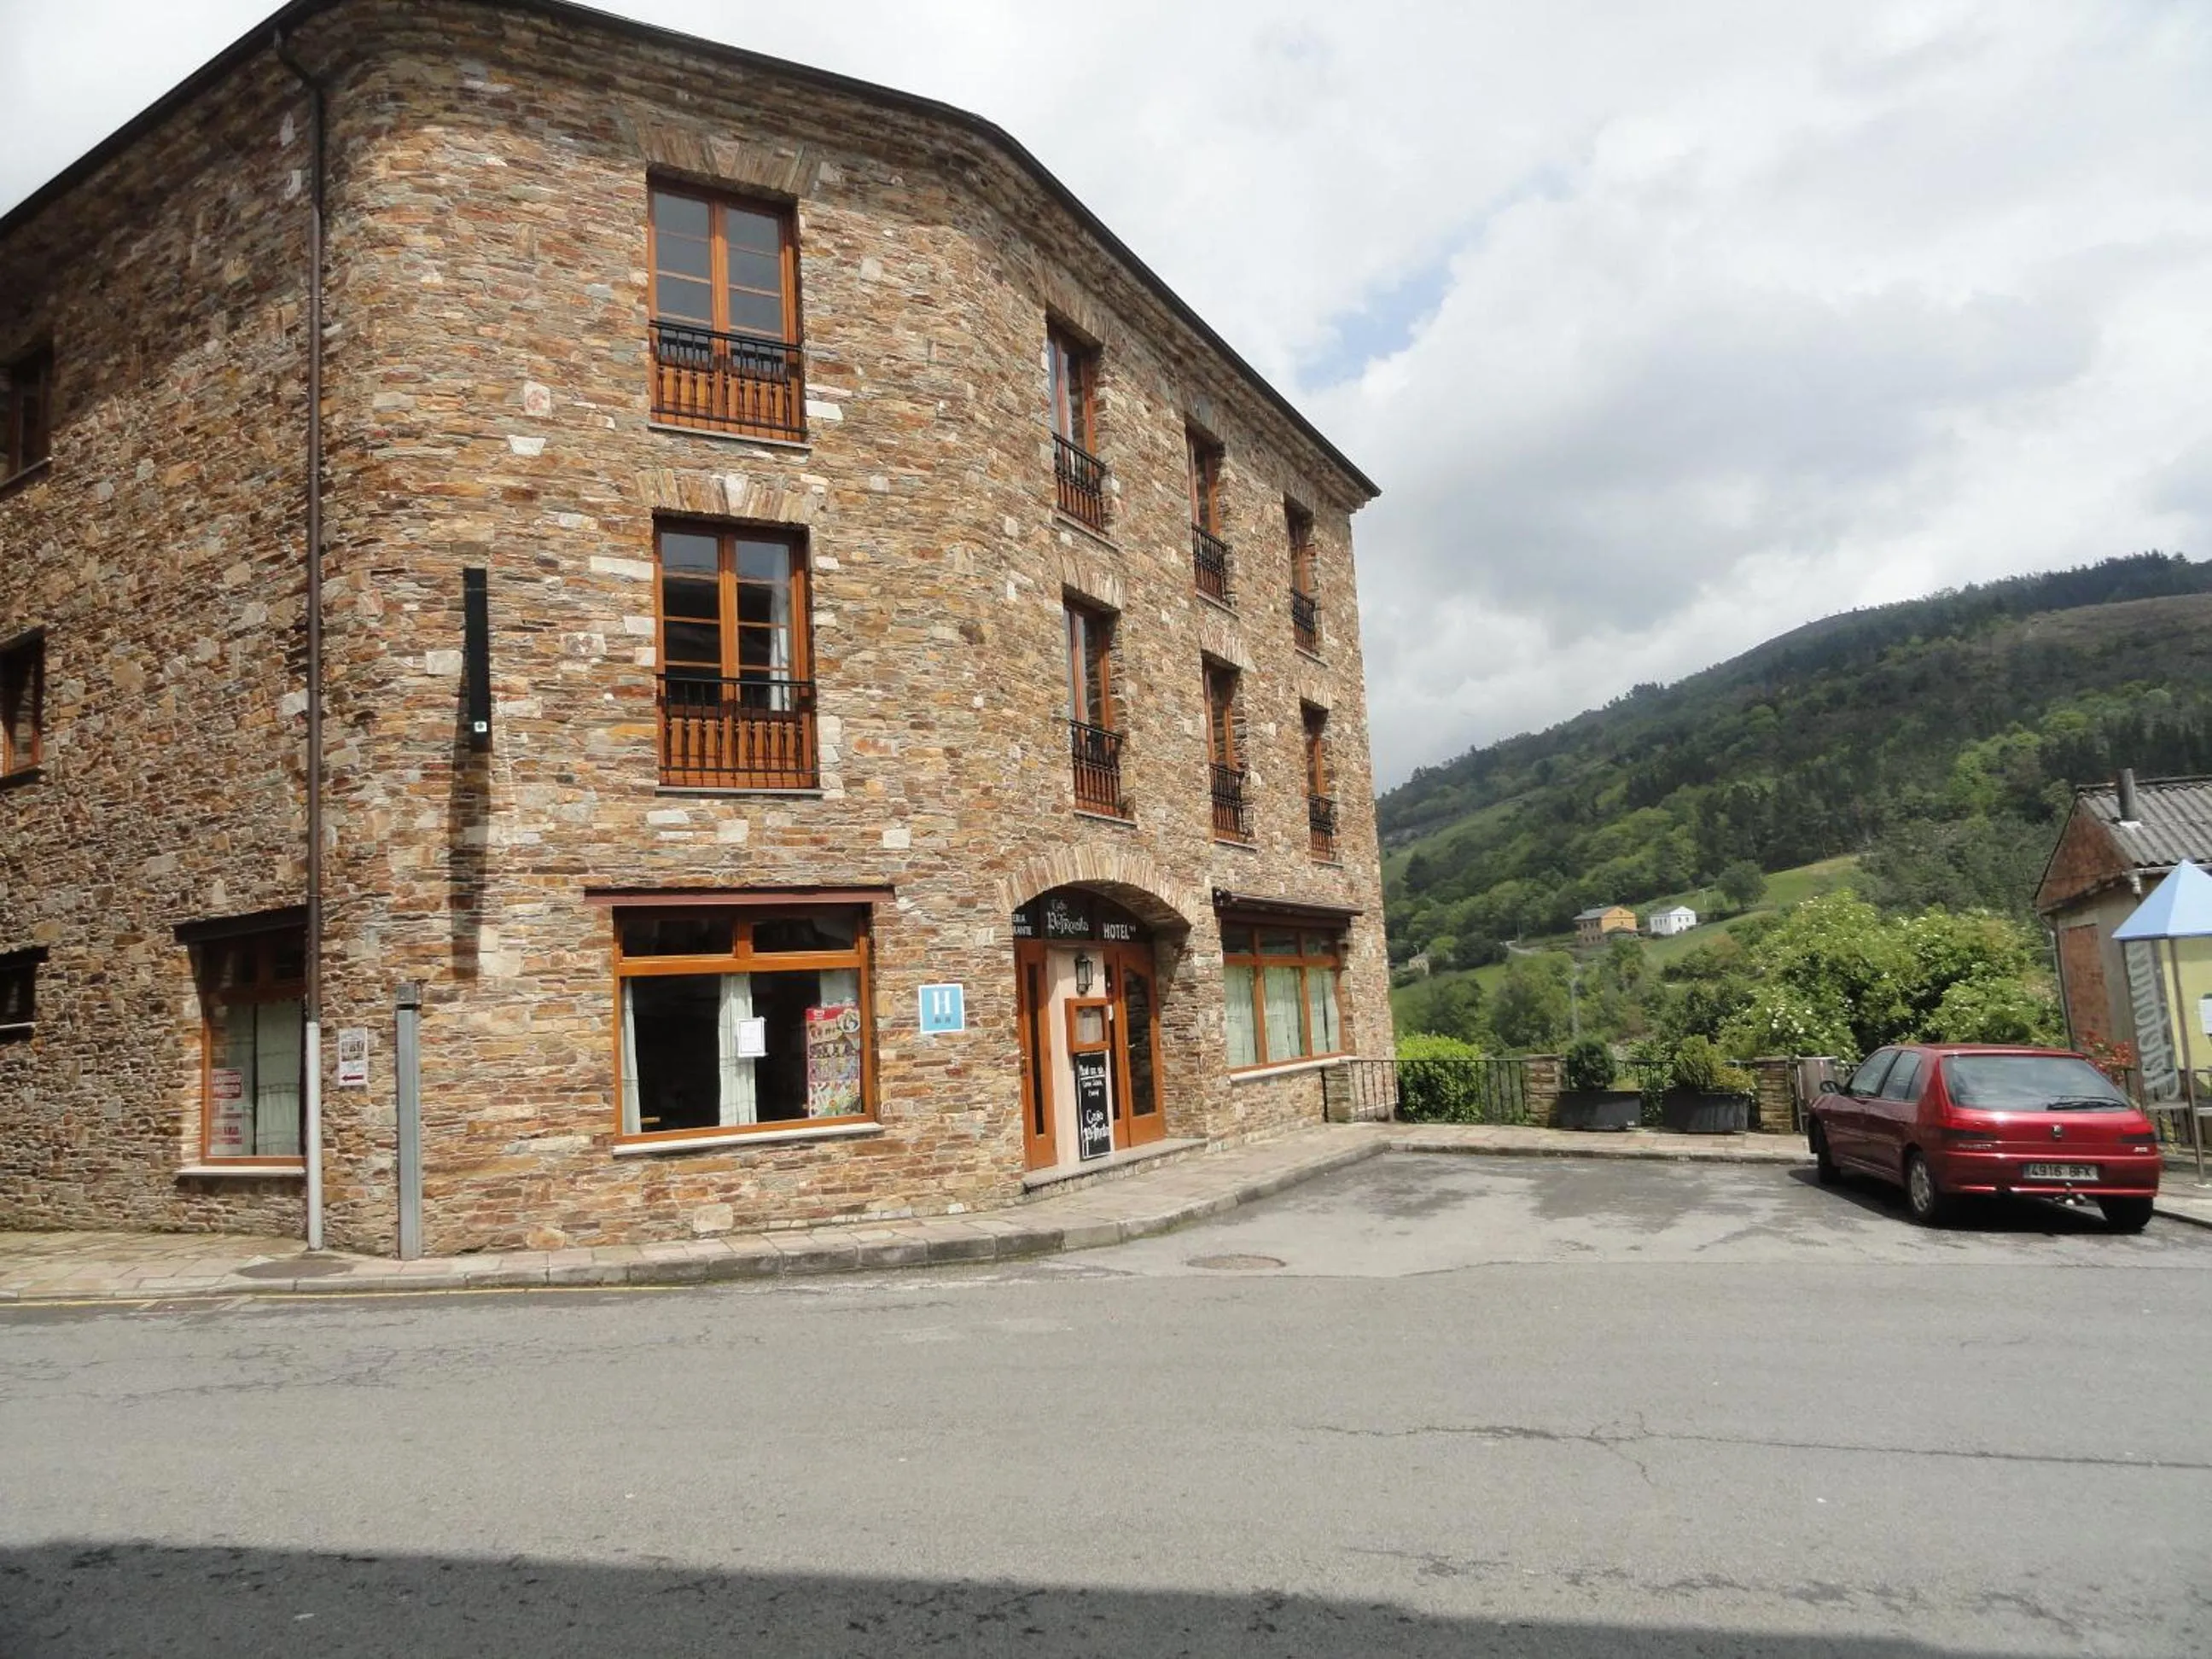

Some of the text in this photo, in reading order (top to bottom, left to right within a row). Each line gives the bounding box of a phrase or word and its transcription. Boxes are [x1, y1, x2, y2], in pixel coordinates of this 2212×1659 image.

[1103, 923, 1130, 940] HOTEL
[933, 990, 953, 1016] H
[2031, 1165, 2063, 1177] 4916
